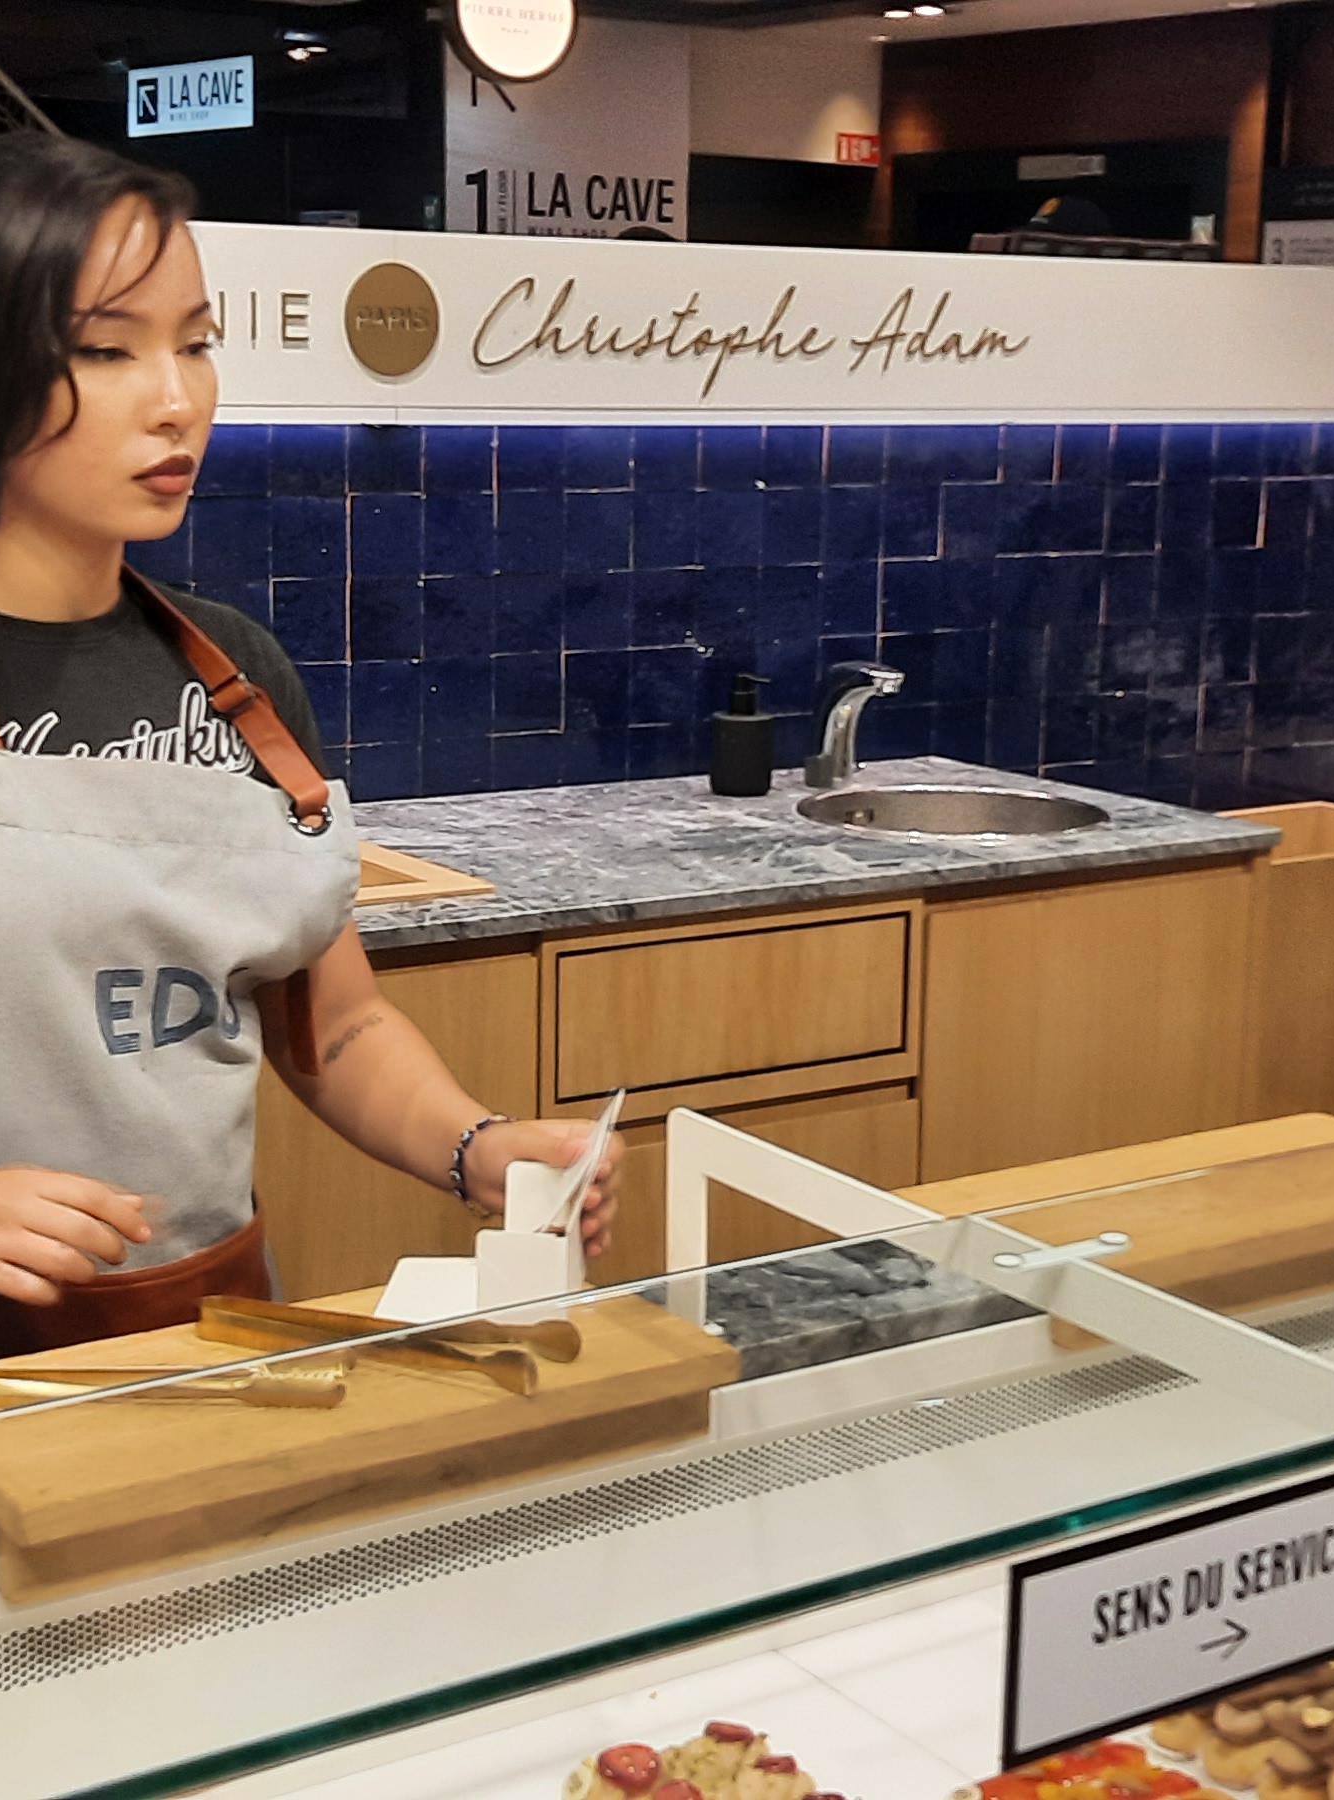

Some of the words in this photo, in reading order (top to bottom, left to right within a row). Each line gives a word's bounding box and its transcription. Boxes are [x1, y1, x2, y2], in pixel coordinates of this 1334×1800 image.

[169, 73, 191, 109] LA
[198, 69, 244, 106] CAVE
[527, 171, 572, 218] LA
[586, 174, 674, 223] CAVE
[355, 306, 430, 331] PARIS
[473, 275, 837, 399] Christophe
[848, 286, 1029, 374] Adam
[1091, 1576, 1173, 1645] SENS
[1182, 1560, 1226, 1617] DU
